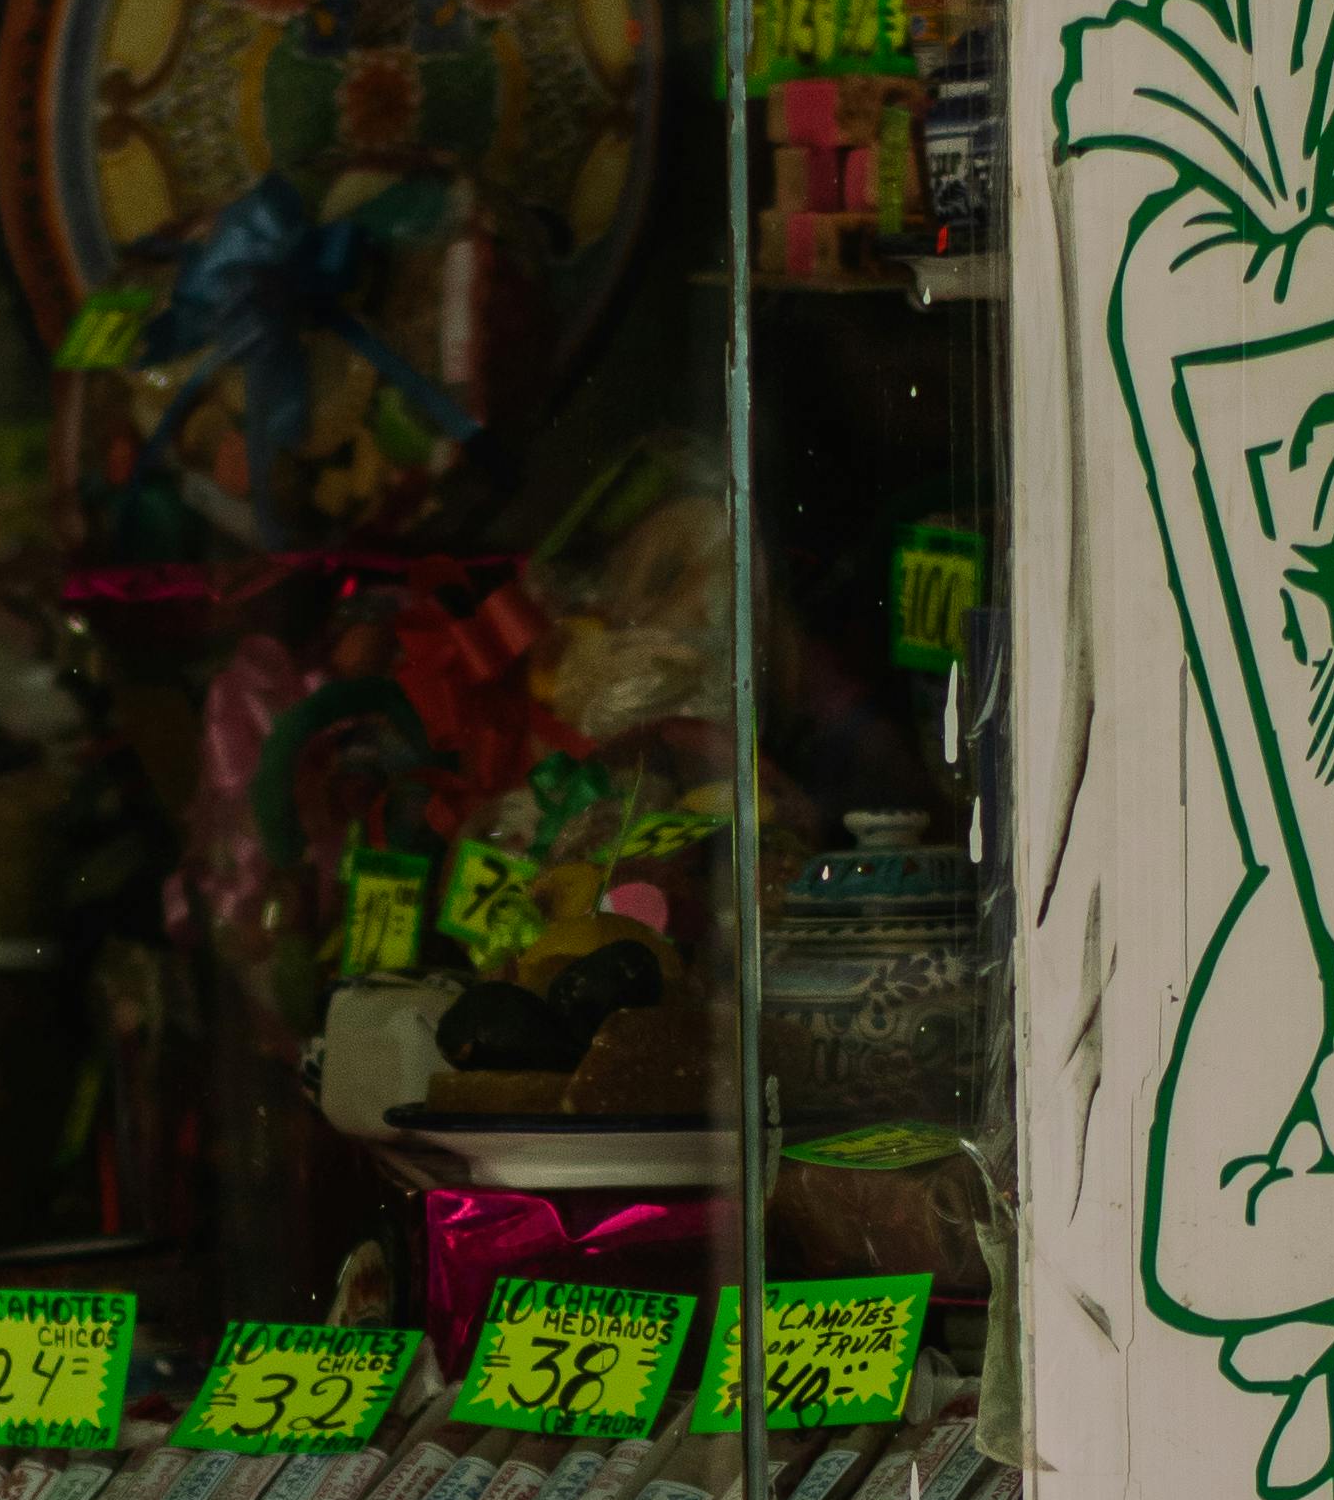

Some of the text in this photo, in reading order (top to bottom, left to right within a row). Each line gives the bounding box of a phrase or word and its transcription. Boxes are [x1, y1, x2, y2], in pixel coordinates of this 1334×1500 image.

[488, 1276, 537, 1325] 10
[545, 1284, 680, 1320] CAMOTES
[779, 1297, 896, 1330] CAMOTES
[38, 1326, 118, 1351] CHICOS
[277, 1327, 407, 1357] CAMOTES
[543, 1311, 674, 1345] MEDIANOS
[814, 1326, 899, 1358] FRUTA
[318, 1355, 399, 1374] CHICOS
